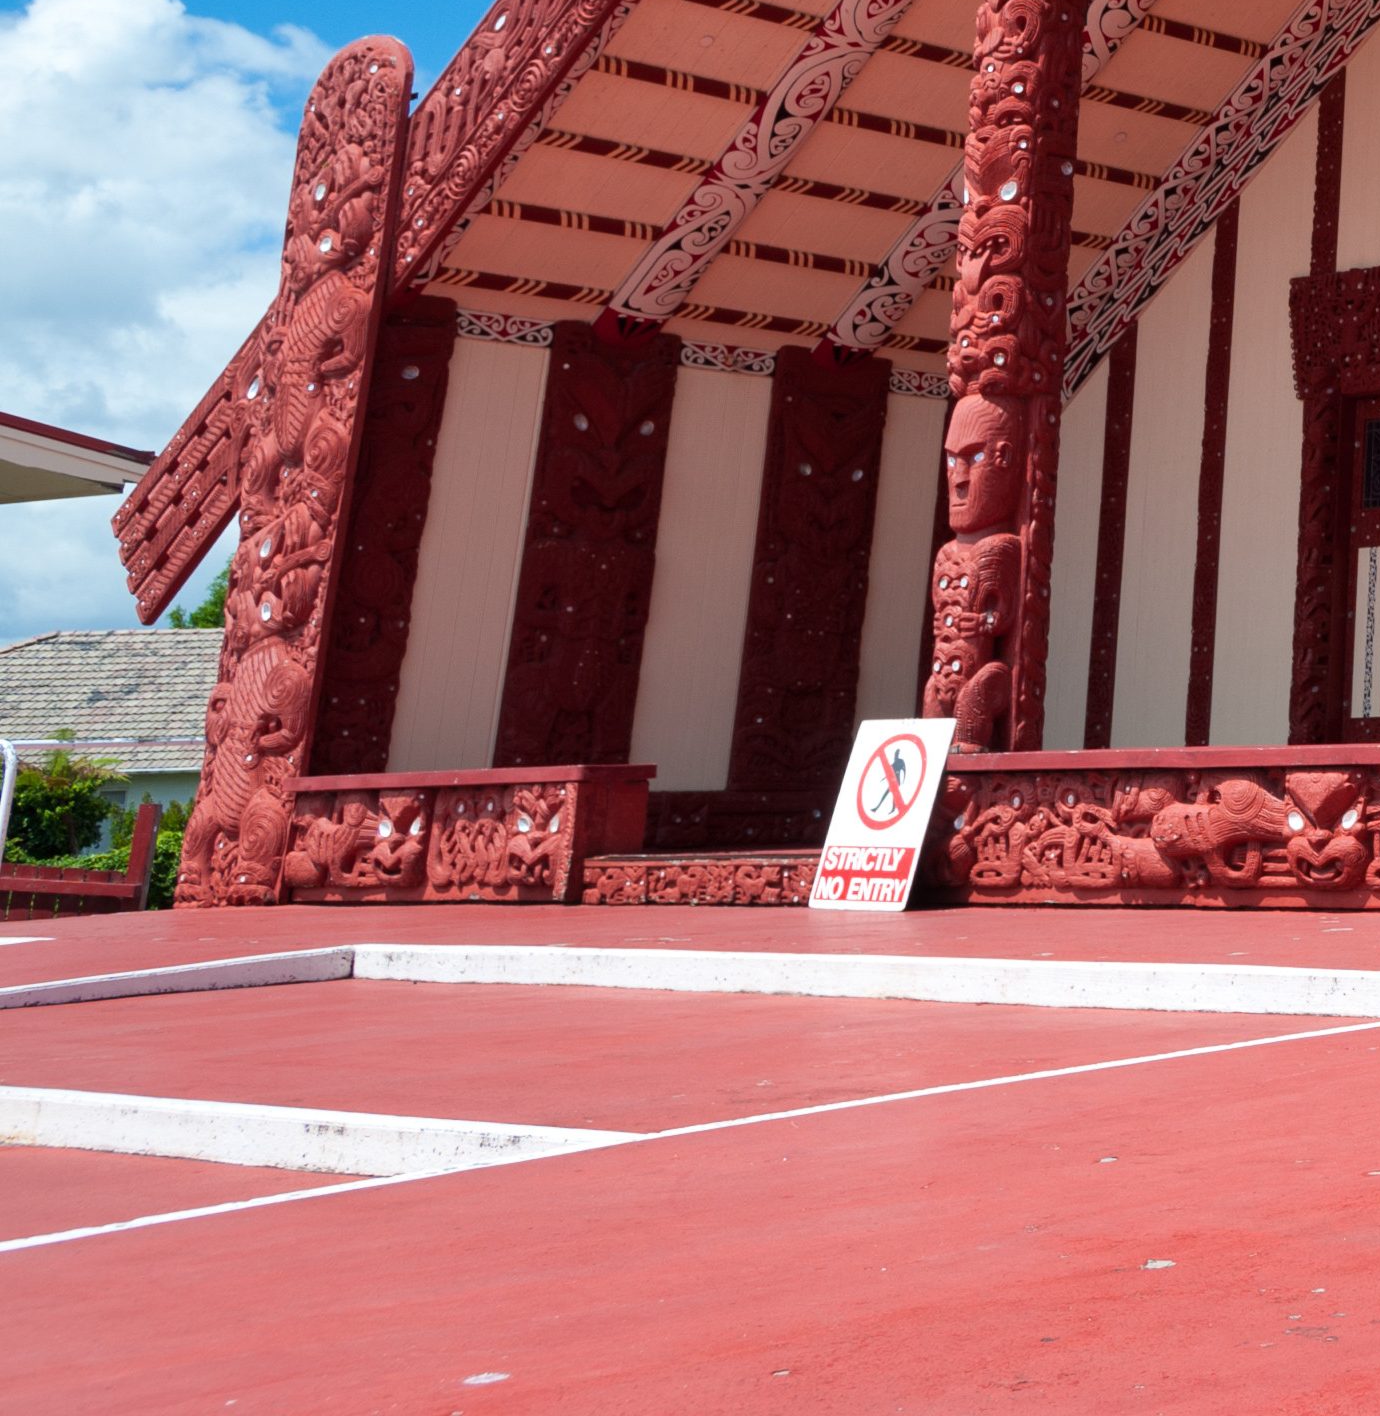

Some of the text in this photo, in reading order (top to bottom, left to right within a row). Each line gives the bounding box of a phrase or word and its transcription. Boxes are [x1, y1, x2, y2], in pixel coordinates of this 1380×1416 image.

[825, 847, 905, 871] STRICTLY
[815, 876, 907, 901] NO ENTRY
